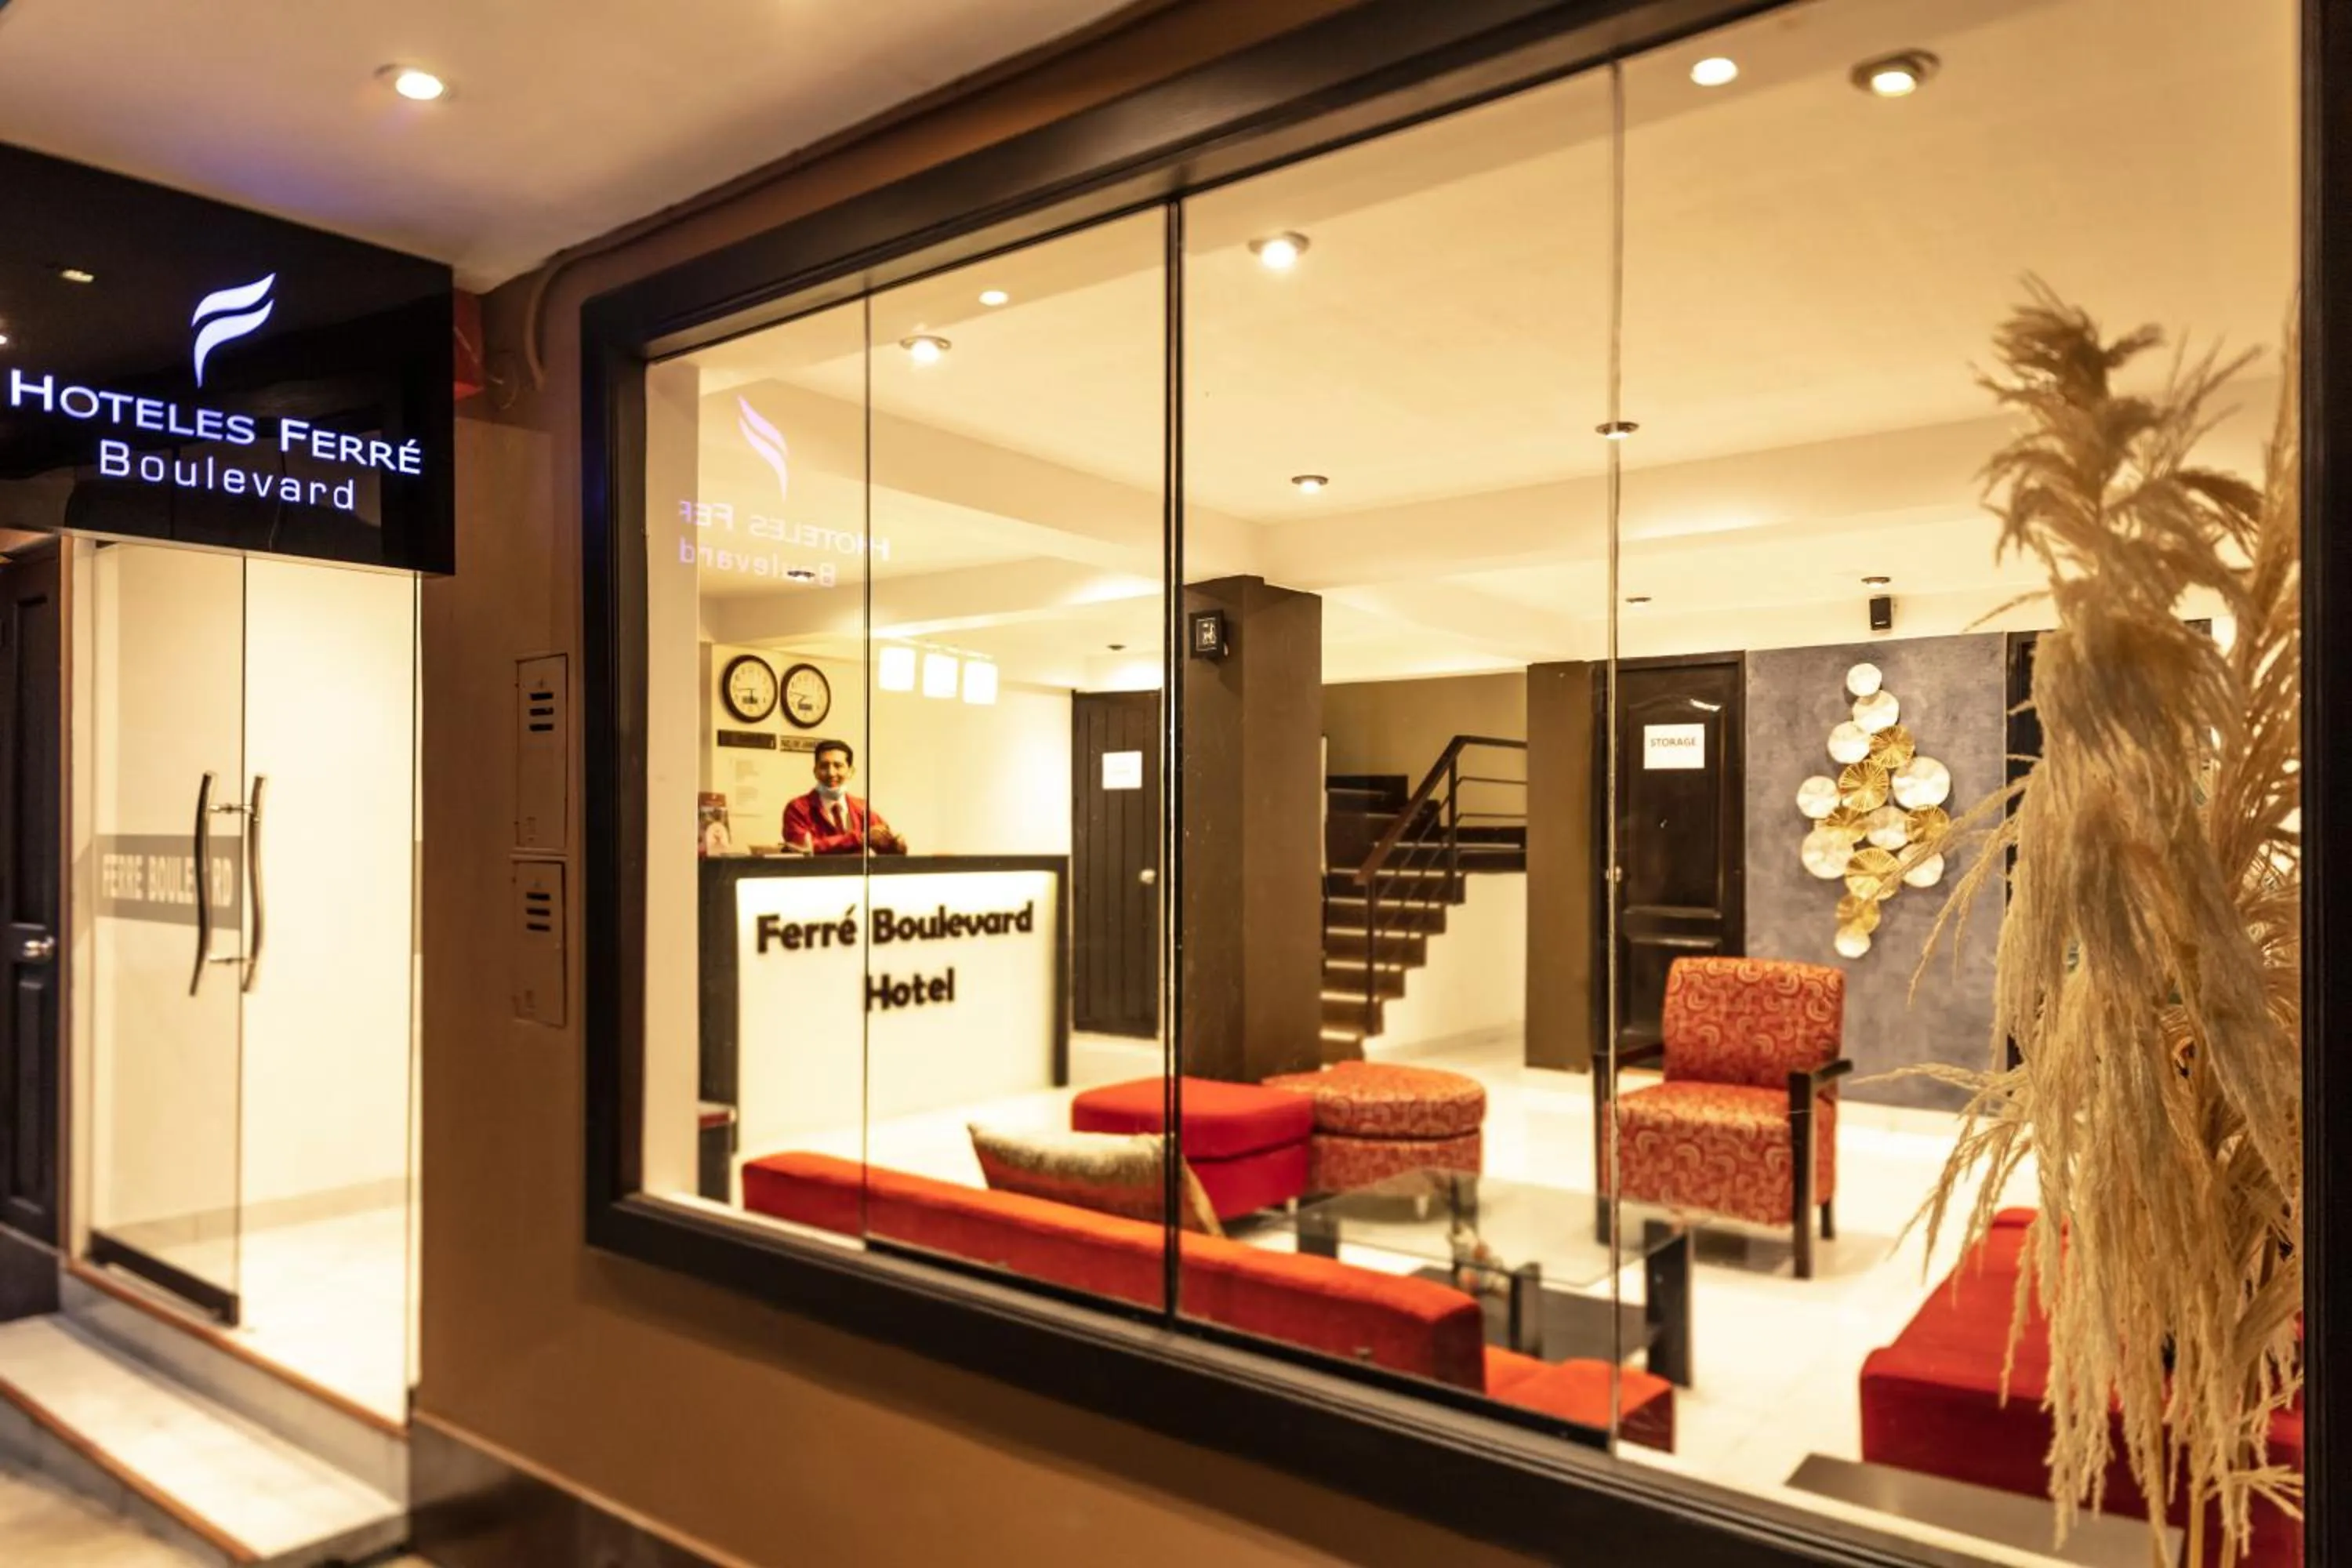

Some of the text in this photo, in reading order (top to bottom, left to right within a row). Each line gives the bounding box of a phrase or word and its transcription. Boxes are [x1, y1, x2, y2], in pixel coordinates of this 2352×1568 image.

[11, 368, 422, 474] HOTELES FERRÉ
[99, 439, 354, 510] Boulevard
[1650, 737, 1697, 747] STORAGE
[148, 855, 233, 907] BOULERD
[757, 900, 1034, 954] Ferré Boulevard
[865, 967, 955, 1012] Hotel
